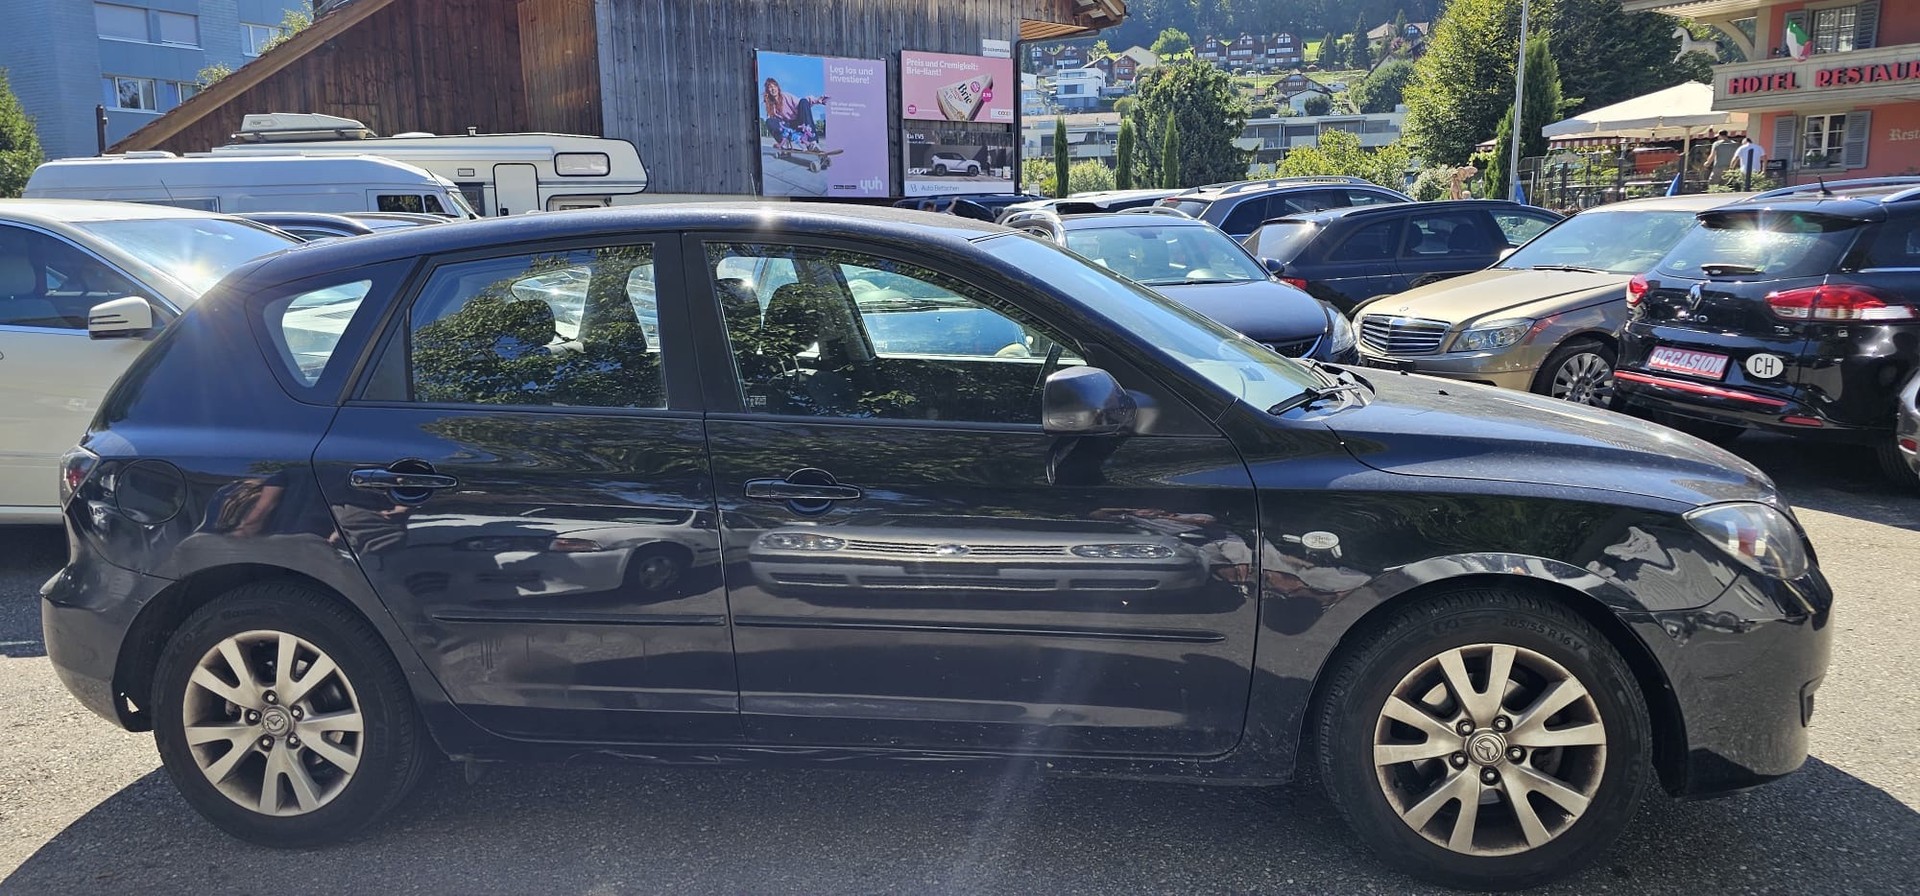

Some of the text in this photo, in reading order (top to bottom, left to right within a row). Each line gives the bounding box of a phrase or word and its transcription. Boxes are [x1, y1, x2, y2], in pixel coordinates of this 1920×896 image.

[830, 65, 874, 76] Leg los und
[906, 58, 924, 67] Preis
[940, 61, 979, 71] Cremigkeit:
[1728, 72, 1798, 94] HOTEL
[958, 83, 973, 104] Brie
[860, 176, 882, 194] yuh
[1650, 349, 1727, 373] OCCASION
[1754, 357, 1774, 375] CH
[1547, 628, 1558, 639] R
